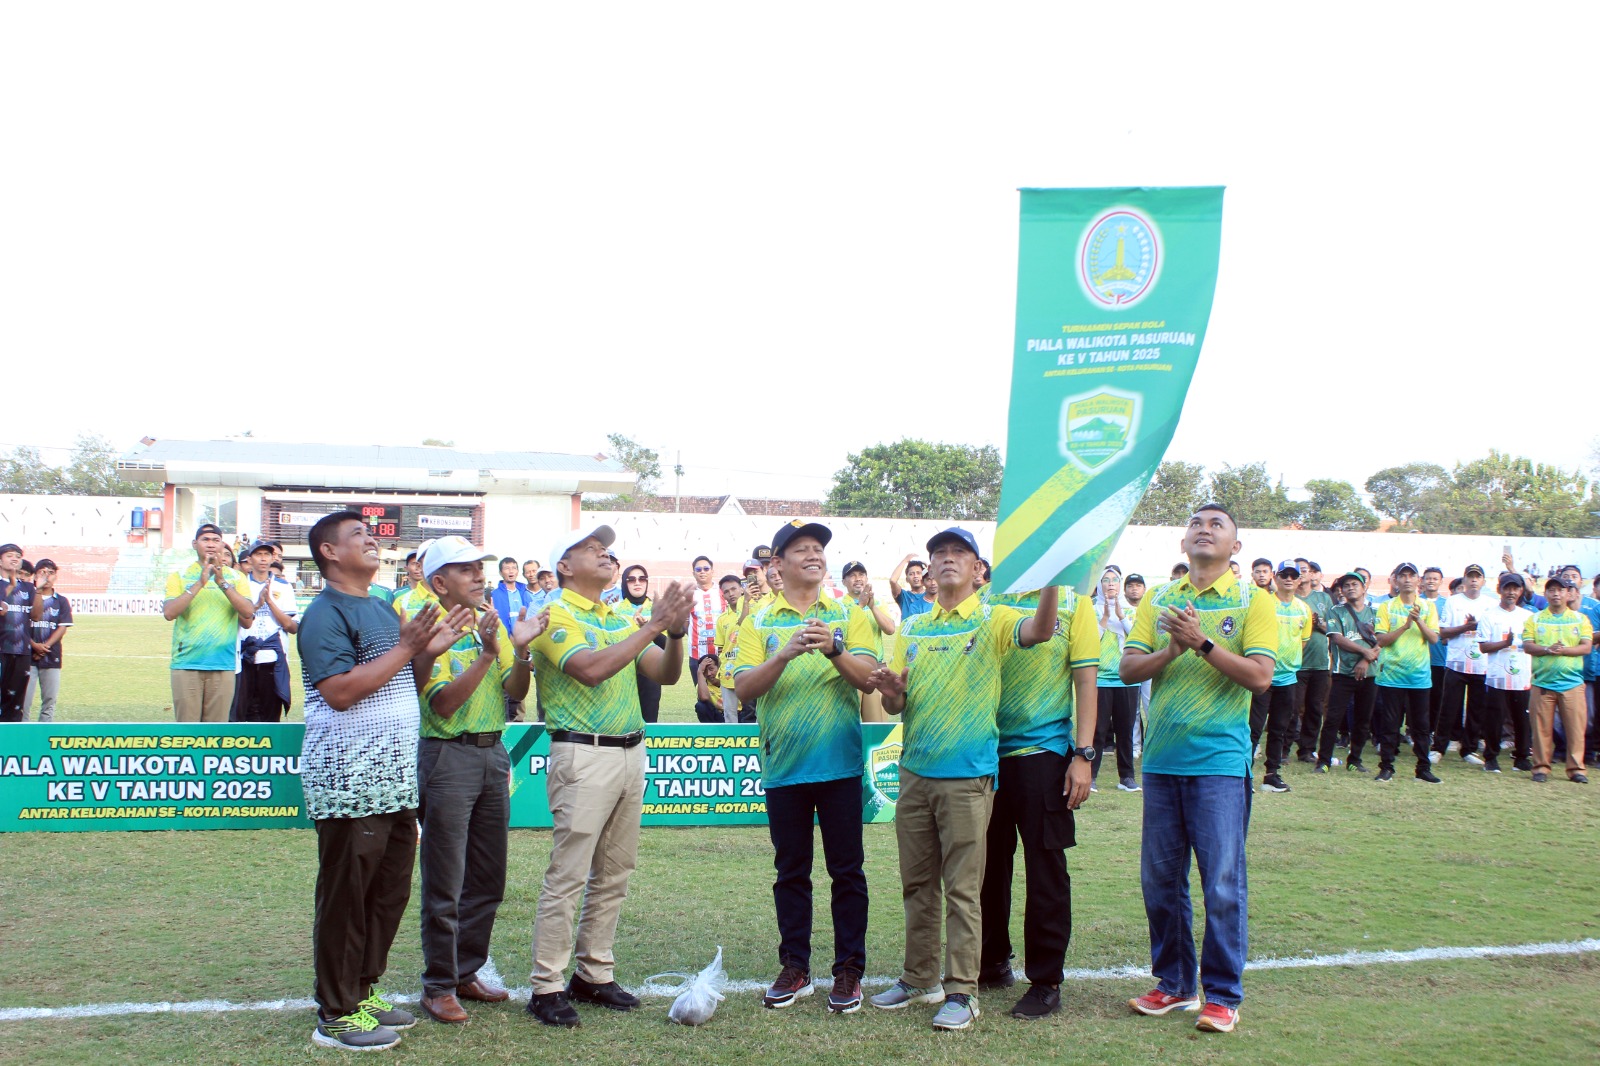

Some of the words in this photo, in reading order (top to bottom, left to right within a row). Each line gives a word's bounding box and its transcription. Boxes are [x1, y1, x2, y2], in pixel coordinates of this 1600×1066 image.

[1062, 323, 1112, 333] TURNAMEN
[1141, 320, 1165, 329] BOLA
[1027, 338, 1063, 351] PIALA
[1066, 334, 1127, 350] WALIKOTA
[1130, 331, 1196, 346] PASURUAN
[1057, 352, 1075, 366] KE
[1078, 352, 1087, 364] V
[1089, 350, 1130, 364] TAHUN
[1131, 347, 1161, 361] 2025
[71, 598, 123, 613] PEMERINTAH
[126, 599, 146, 613] KOTA
[49, 736, 158, 750] TURNAMEN
[159, 736, 221, 749] SEPAK
[221, 736, 272, 749] BOLA
[693, 736, 749, 749] SEPAK
[62, 755, 196, 775] WALIKOTA
[203, 755, 302, 775] PASURU
[48, 781, 84, 801] KE
[90, 781, 110, 800] V
[116, 781, 205, 801] TAHUN
[212, 780, 272, 799] 2025
[654, 778, 734, 797] TAHUN
[18, 808, 69, 819] ANTAR
[70, 807, 158, 819] KELURAHAN
[222, 805, 299, 818] PASURUAN
